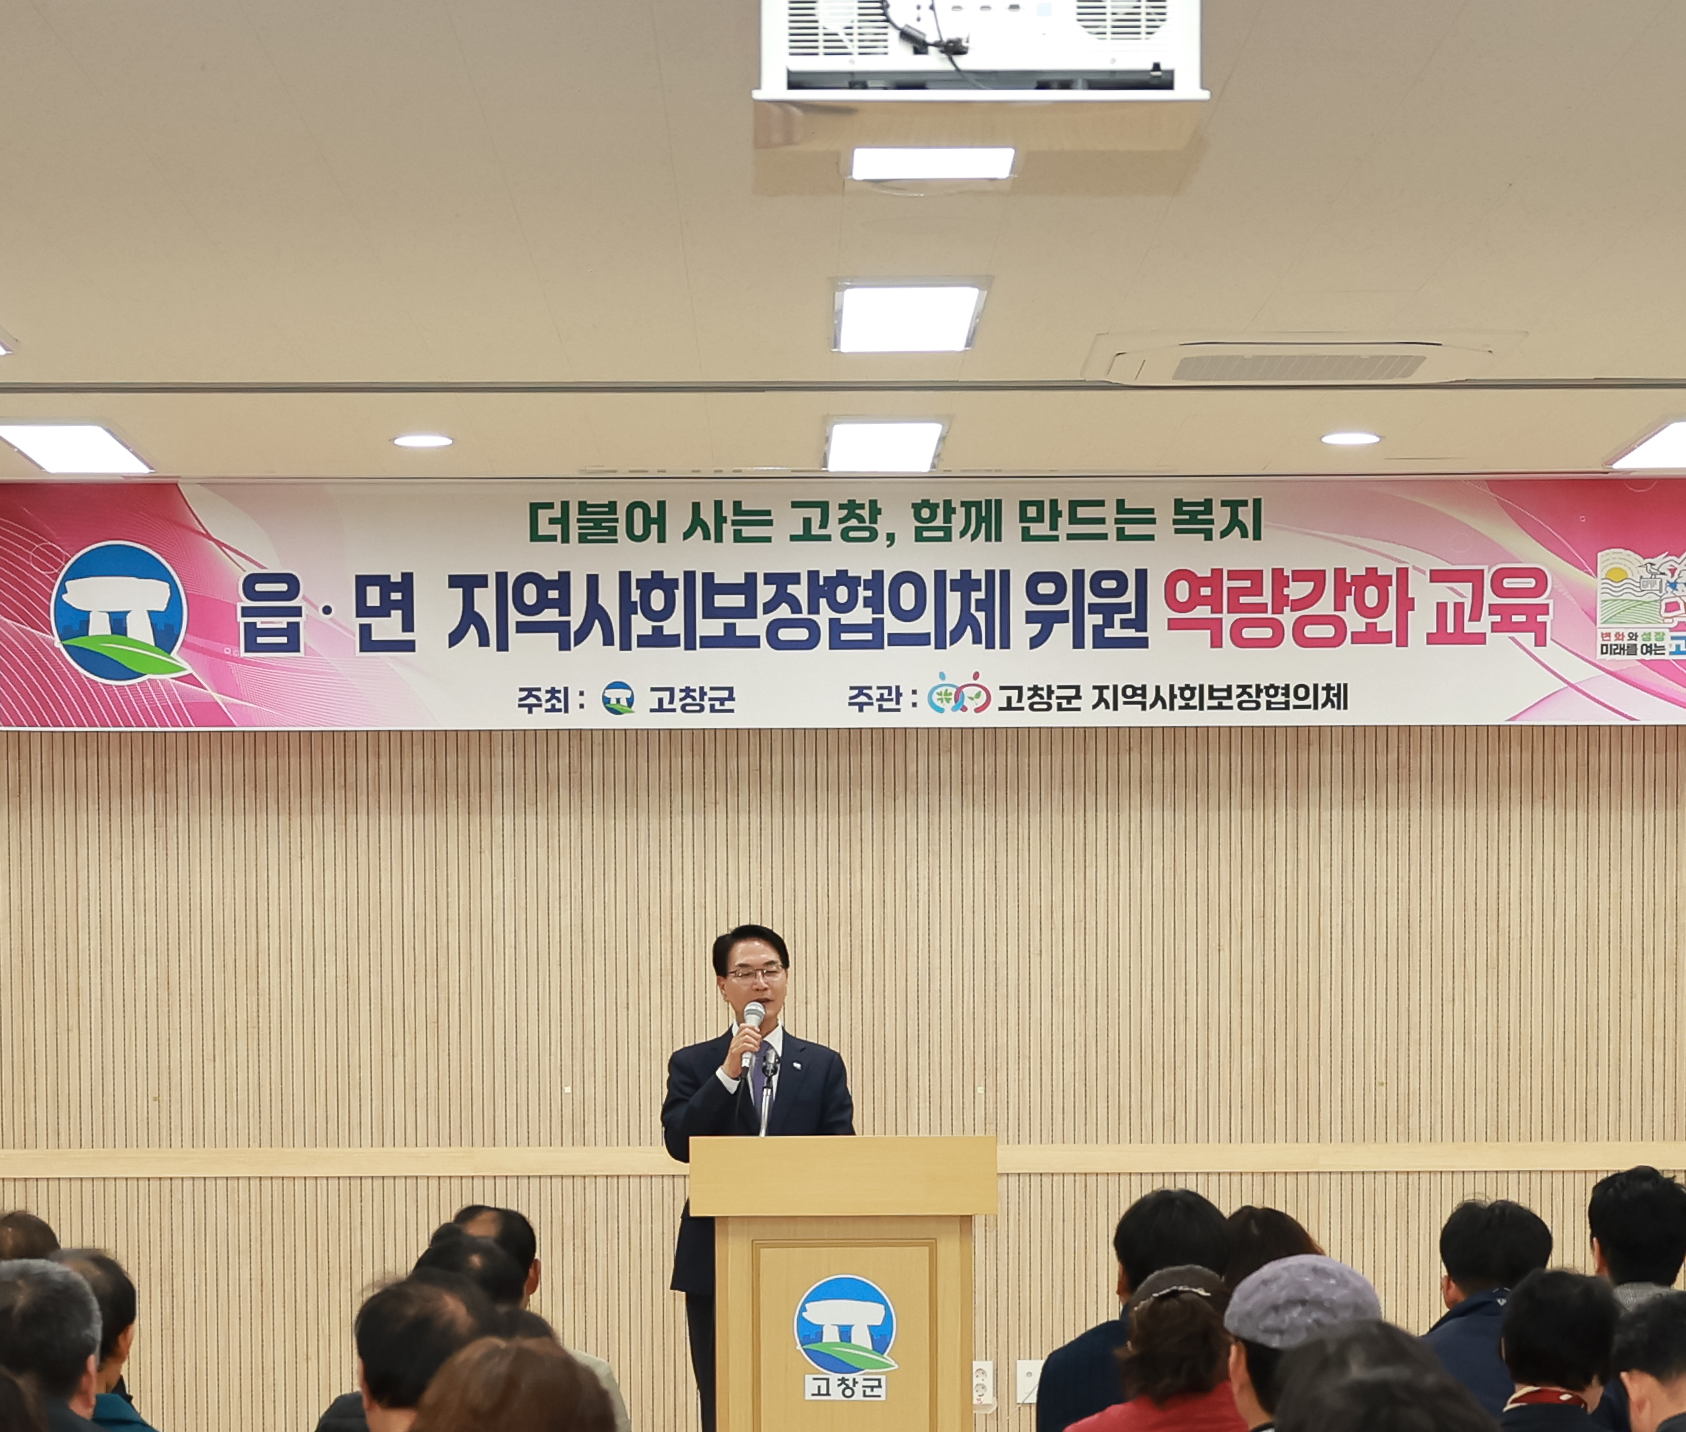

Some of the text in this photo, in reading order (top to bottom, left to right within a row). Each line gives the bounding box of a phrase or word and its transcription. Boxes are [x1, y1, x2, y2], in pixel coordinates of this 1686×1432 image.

[528, 497, 1263, 549] 더불어 사는 고창, 함께 만드는 복지
[447, 568, 1011, 652] 지역사회보장협의체
[1025, 568, 1149, 650] 위원
[1164, 566, 1415, 649] 역량강화
[1426, 567, 1550, 647] 교육
[1600, 643, 1666, 656] 미래를 여는
[649, 685, 736, 714] 고창군
[997, 684, 1083, 712] 고창군
[1091, 682, 1348, 712] 지역사회보장협의체
[811, 1376, 882, 1399] 고창군
